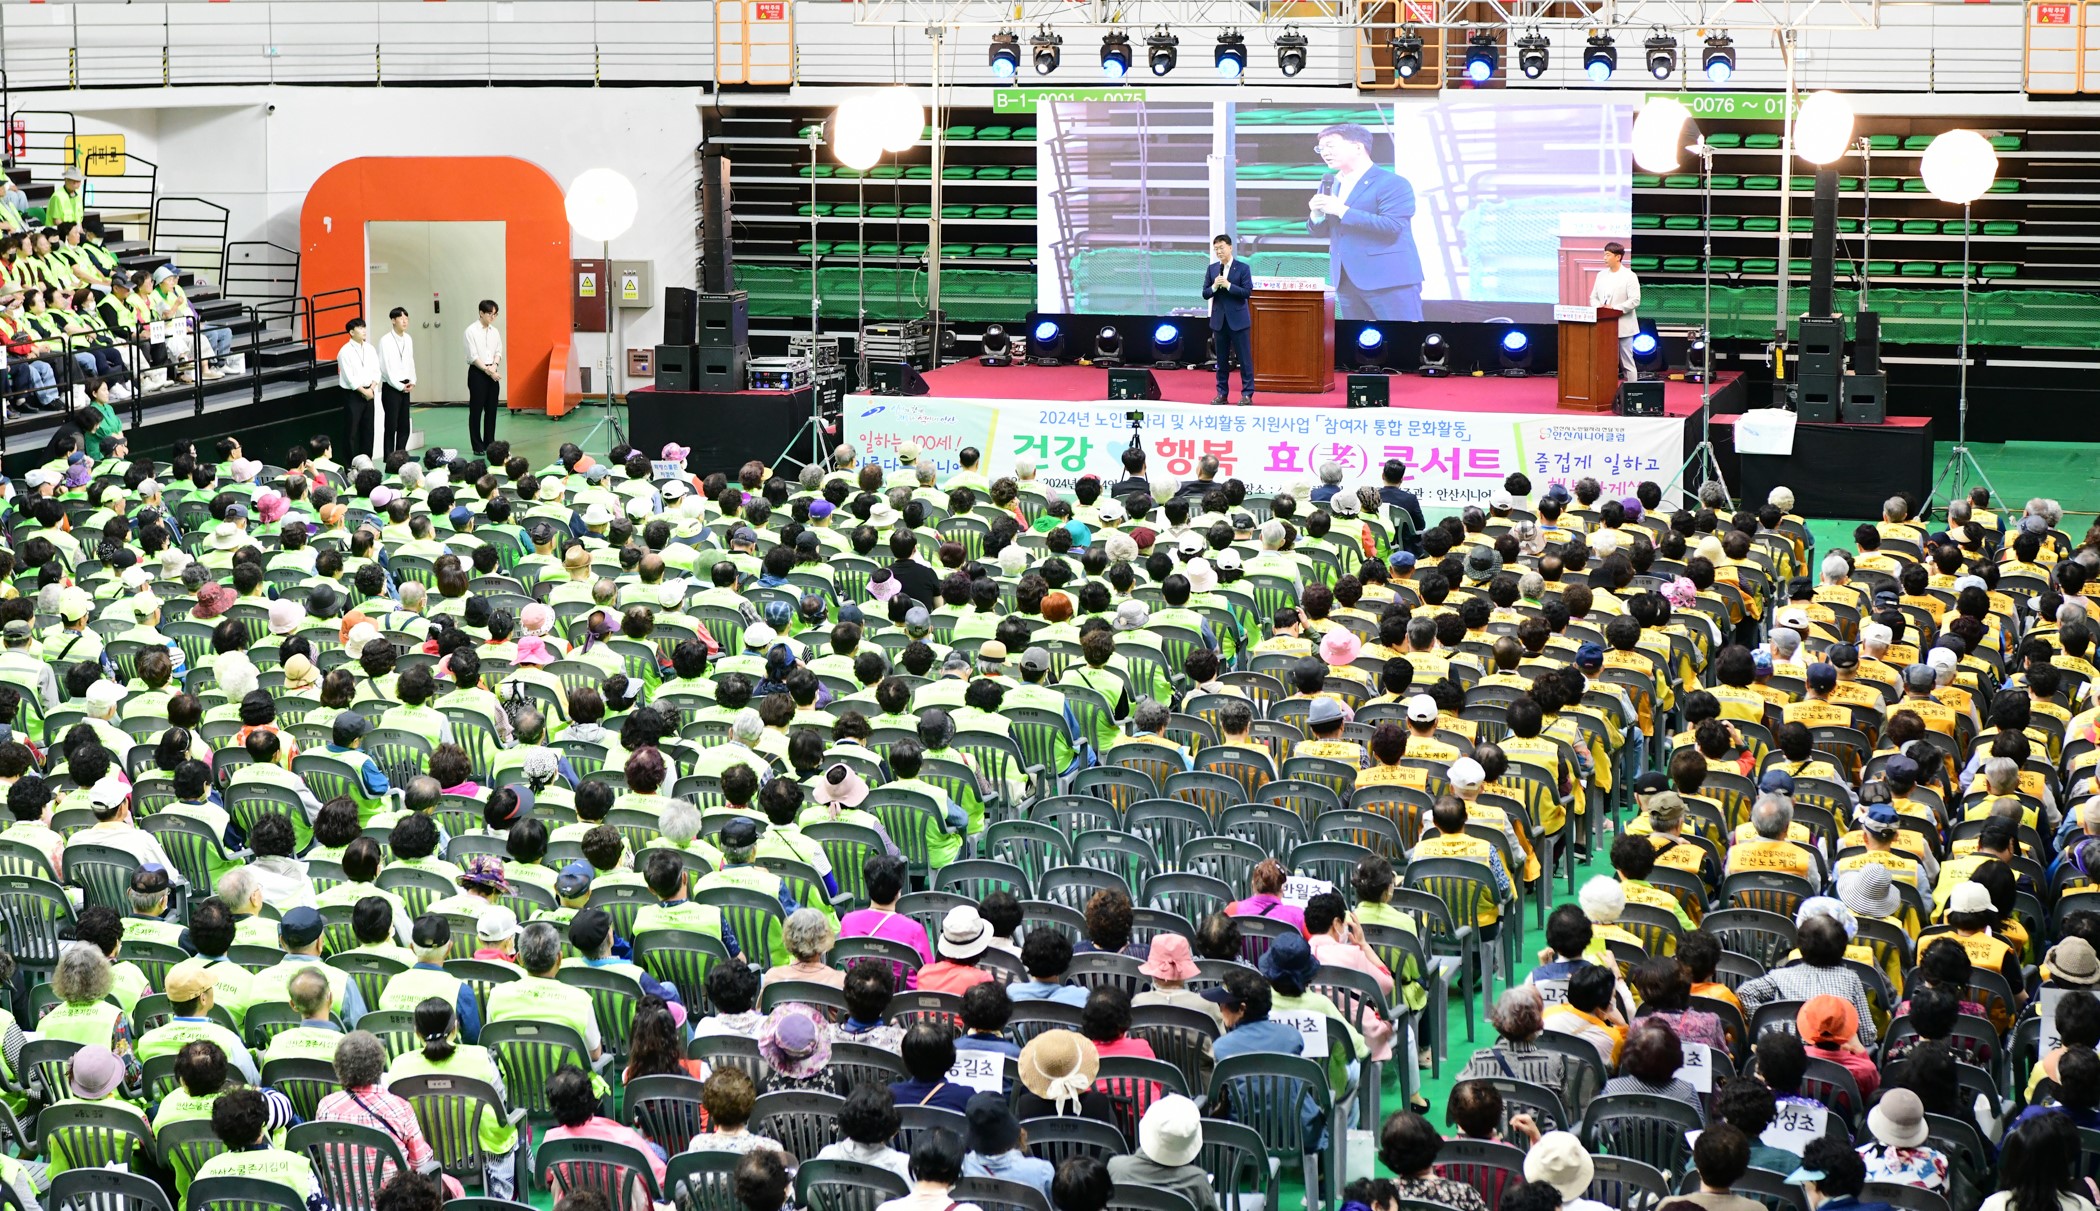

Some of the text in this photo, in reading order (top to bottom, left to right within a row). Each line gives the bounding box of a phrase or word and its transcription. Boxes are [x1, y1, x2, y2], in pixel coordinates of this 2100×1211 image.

[87, 146, 118, 165] 대피로
[1039, 411, 1090, 428] 2024년
[1171, 414, 1184, 430] 및
[1189, 415, 1247, 433] 사회활동
[1252, 416, 1309, 434] 지원사업
[1316, 415, 1368, 435] 「참여자
[1373, 419, 1402, 436] 통합
[1407, 420, 1471, 441] 문화활동」
[860, 430, 902, 454] 일하는
[1552, 432, 1626, 443] 안산시니어클럽
[1013, 435, 1093, 473] 건강
[1155, 437, 1238, 477] 행복
[1378, 445, 1504, 481] 콘서트
[1534, 452, 1660, 476] 즐겁게 일하고
[1437, 488, 1494, 502] 안산시니어
[1608, 656, 1645, 666] 산노노케어
[1717, 690, 1756, 700] 산노노케어
[1793, 712, 1841, 720] 안산노노케어
[1509, 742, 1549, 751] 산노노케어
[1408, 751, 1448, 760] 산노노케어
[1365, 772, 1416, 781] 안산노노케어
[1424, 847, 1477, 856] 안산노노케어
[1740, 857, 1797, 868] 안산노노케어
